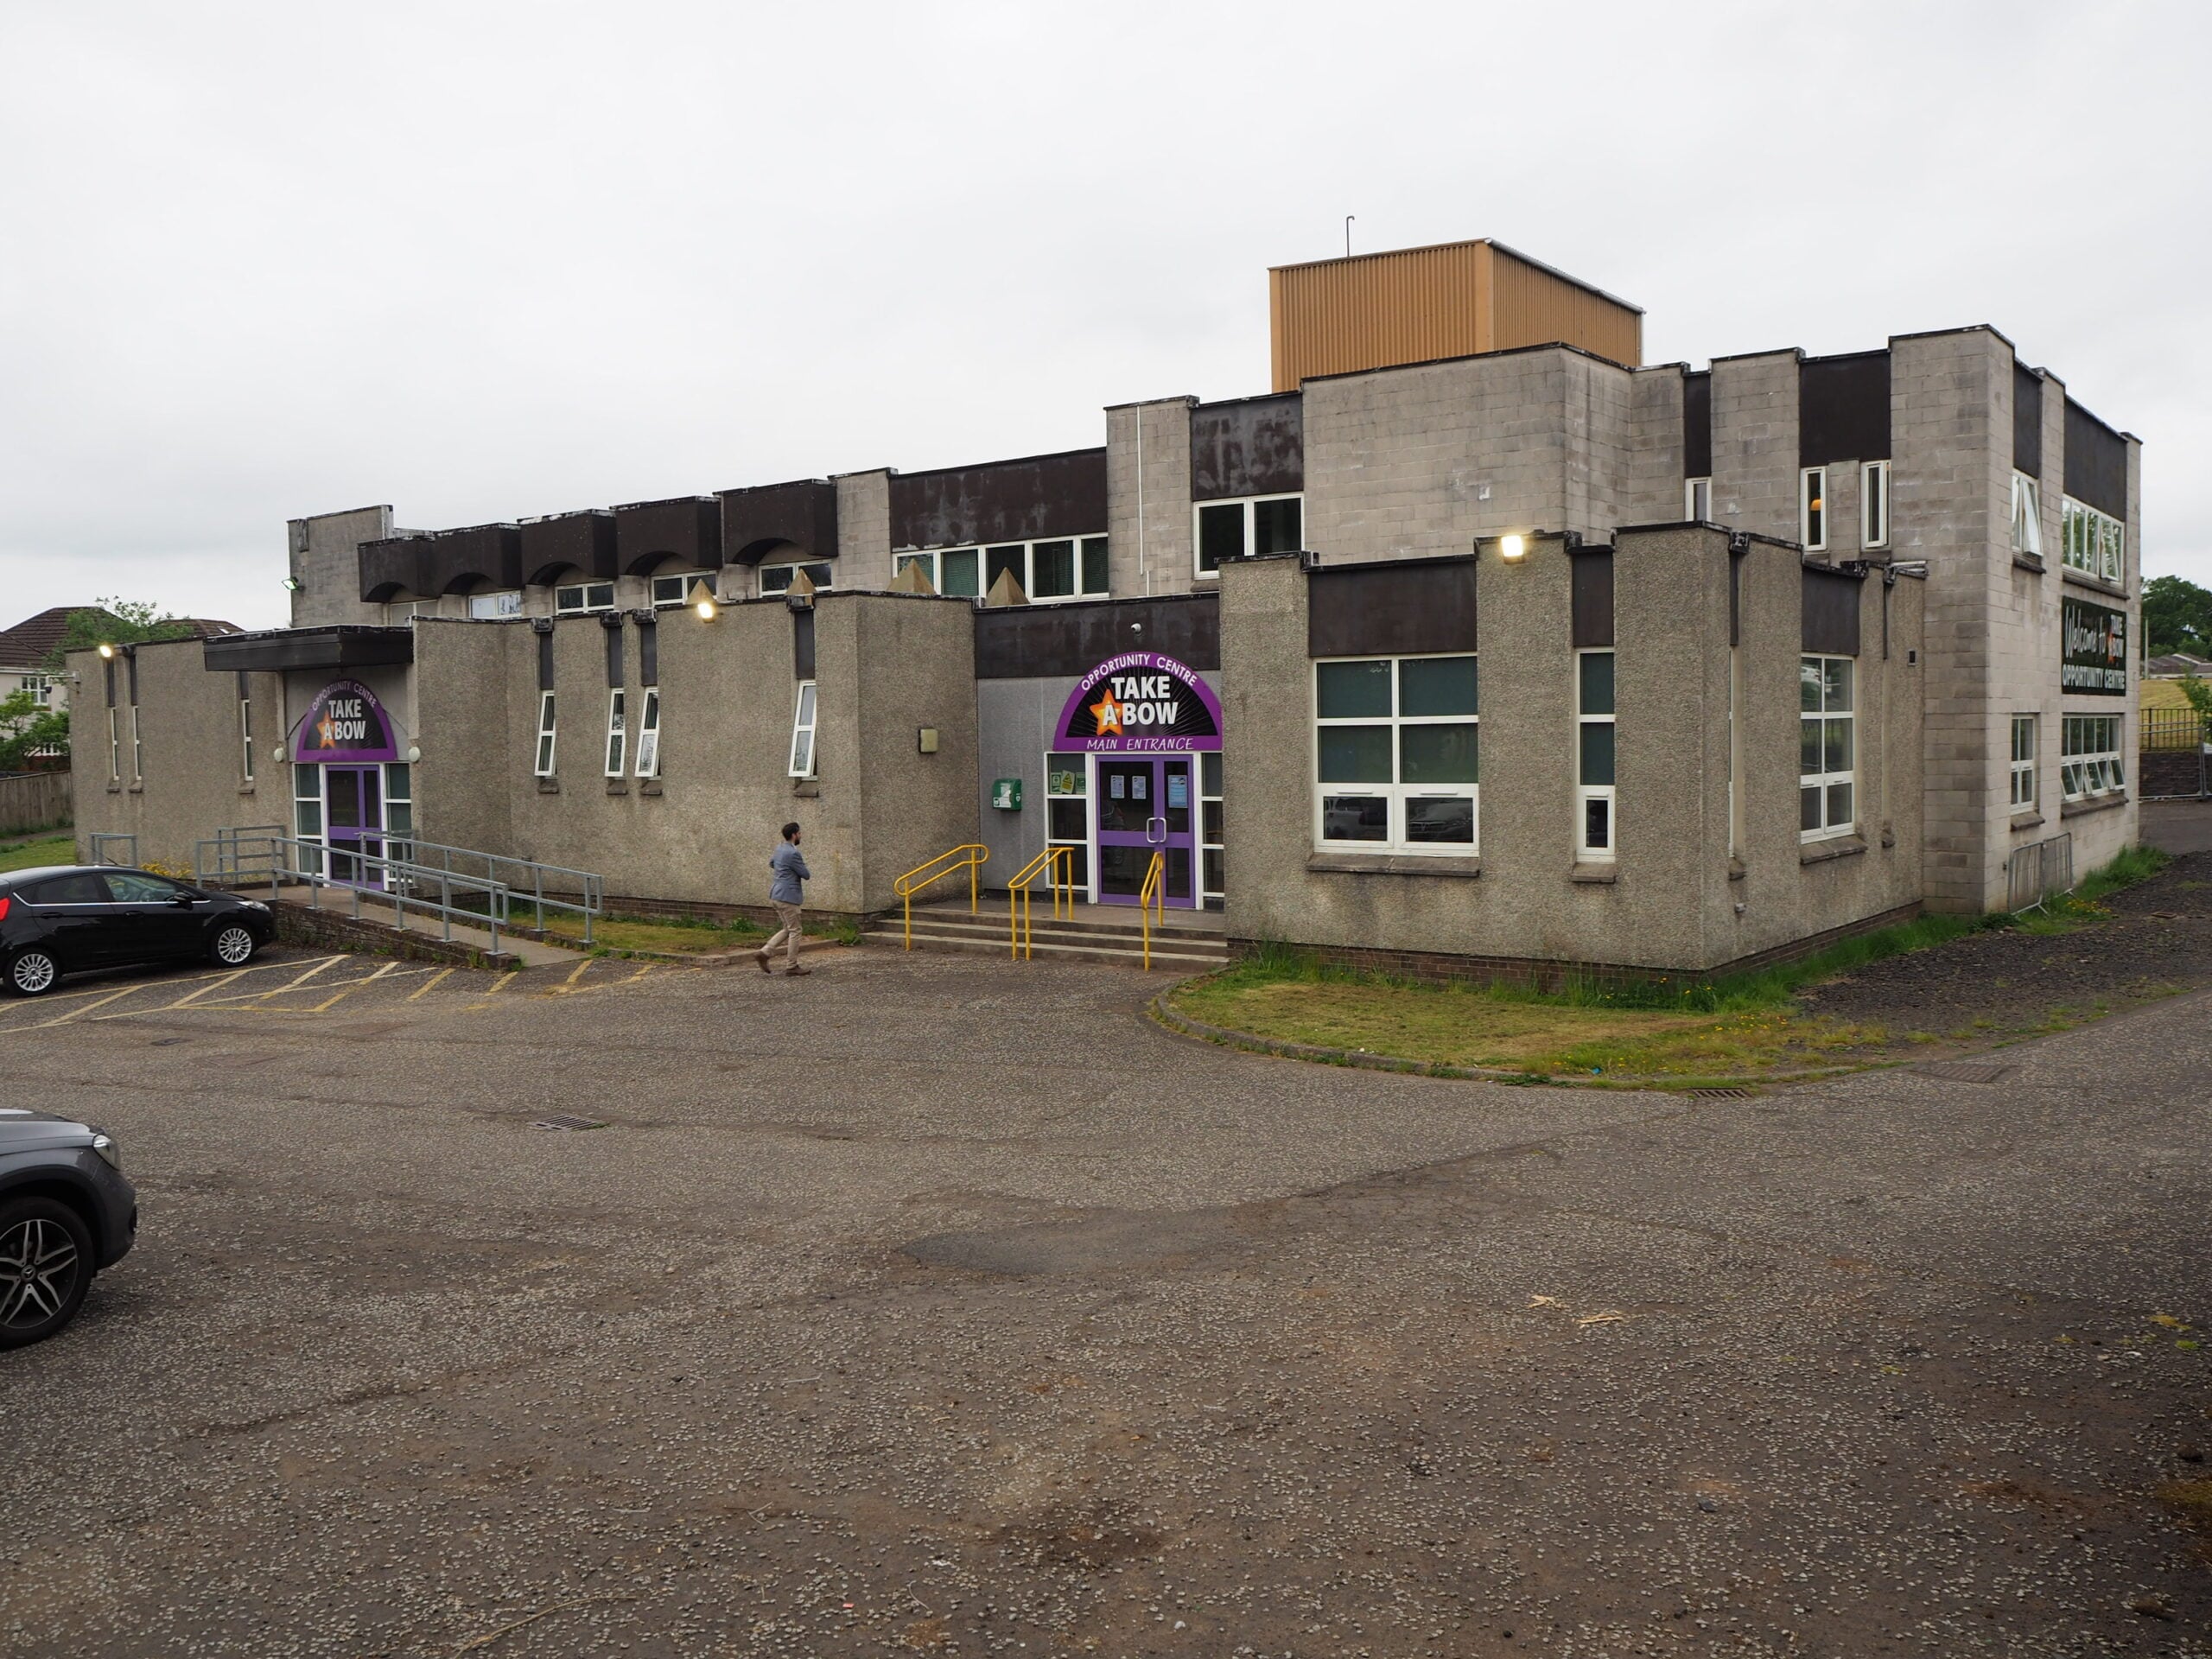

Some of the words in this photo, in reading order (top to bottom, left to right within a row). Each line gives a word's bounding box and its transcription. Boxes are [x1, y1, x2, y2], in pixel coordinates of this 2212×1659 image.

[2065, 605, 2097, 658] Welcome
[1082, 654, 1151, 690] OPPORTUNITY
[1157, 657, 1198, 686] CENTRE
[2063, 664, 2103, 688] OPPORTUNITY
[2104, 668, 2125, 690] CENTRE
[312, 680, 352, 711] OPPORTUNITY
[353, 683, 377, 708] CENTRE
[1111, 676, 1171, 699] TAKE
[328, 699, 361, 718] TAKE
[1102, 704, 1117, 726] A
[1122, 702, 1178, 725] BOW
[324, 723, 333, 740] A
[334, 721, 366, 740] BOW
[1087, 739, 1117, 750] MAIN
[1127, 737, 1194, 750] ENTRANCE
